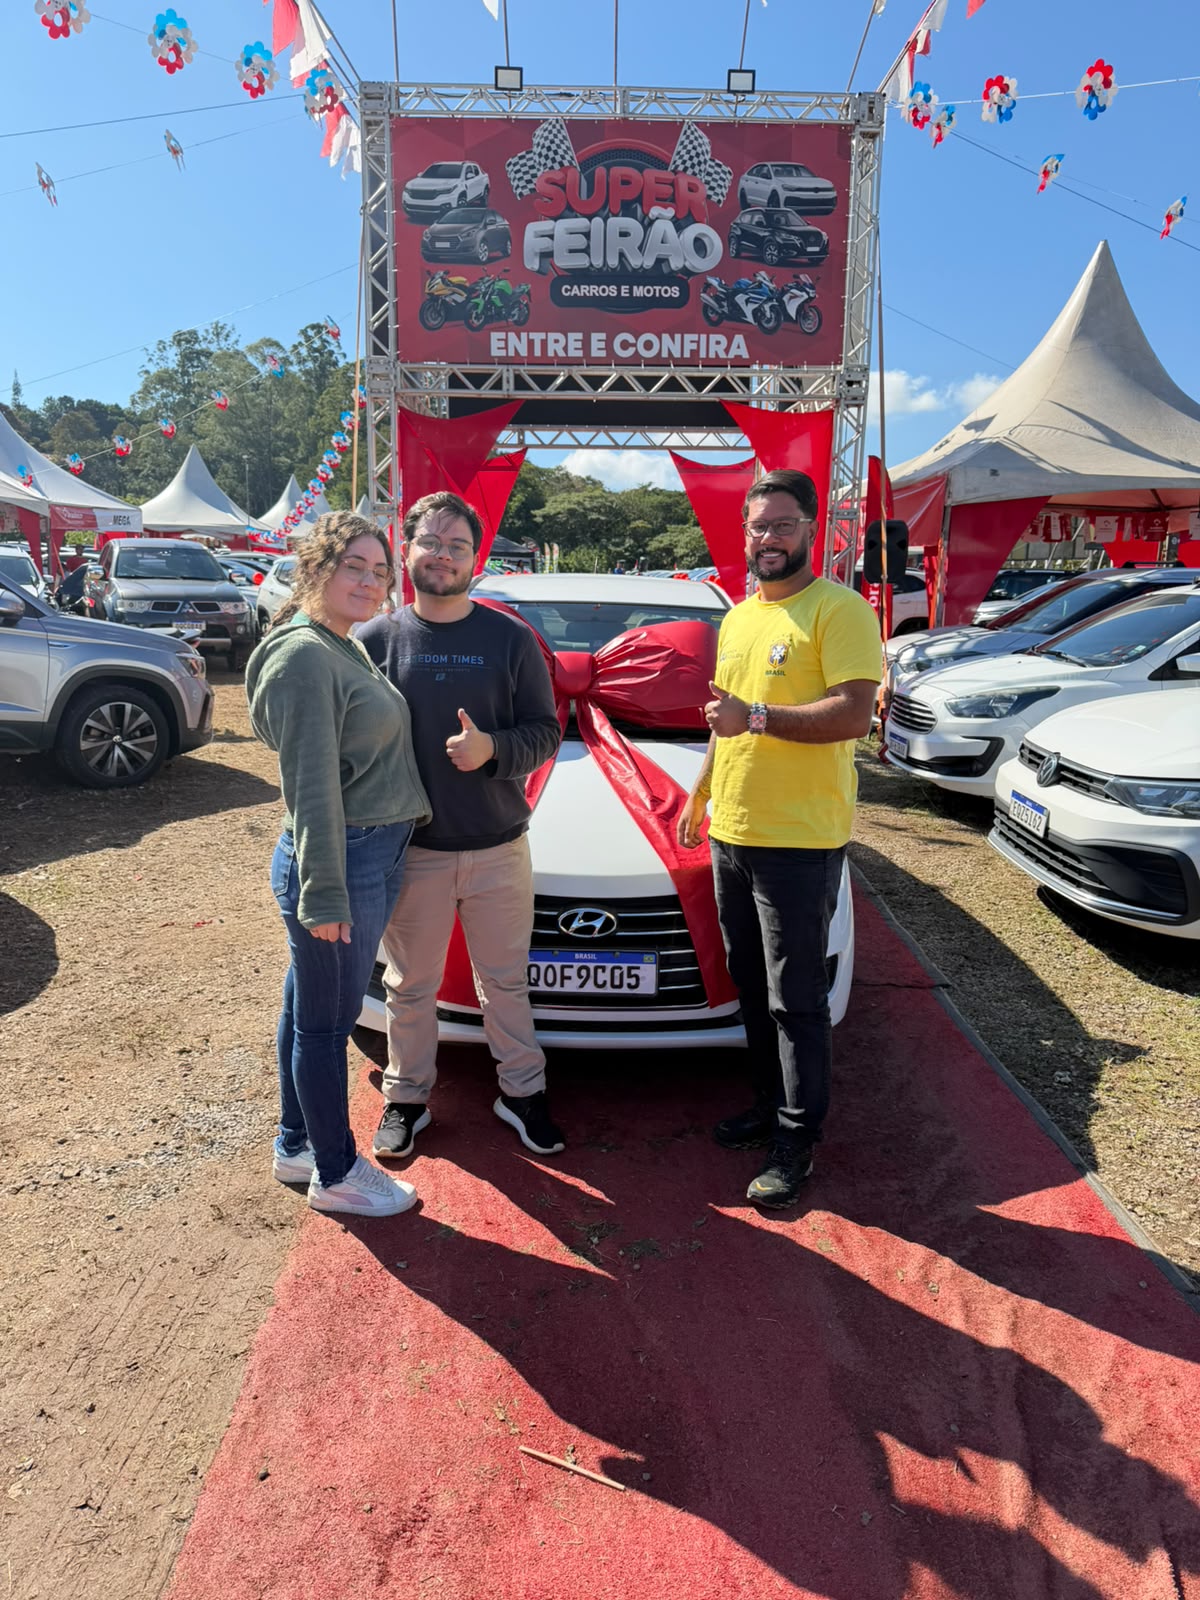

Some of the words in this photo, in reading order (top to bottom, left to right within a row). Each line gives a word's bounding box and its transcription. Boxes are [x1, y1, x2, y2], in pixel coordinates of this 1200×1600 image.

[533, 165, 708, 222] SUPER
[523, 206, 723, 274] FEIRÃO
[561, 284, 618, 297] CARROS
[620, 285, 630, 297] E
[632, 285, 680, 298] MOTOS
[490, 332, 583, 358] ENTRE
[590, 333, 606, 358] E
[613, 333, 749, 359] CONFIRA
[113, 515, 131, 526] MEGA
[452, 654, 484, 665] TIMES
[765, 669, 786, 677] BRASIL
[574, 952, 598, 960] BRASIL
